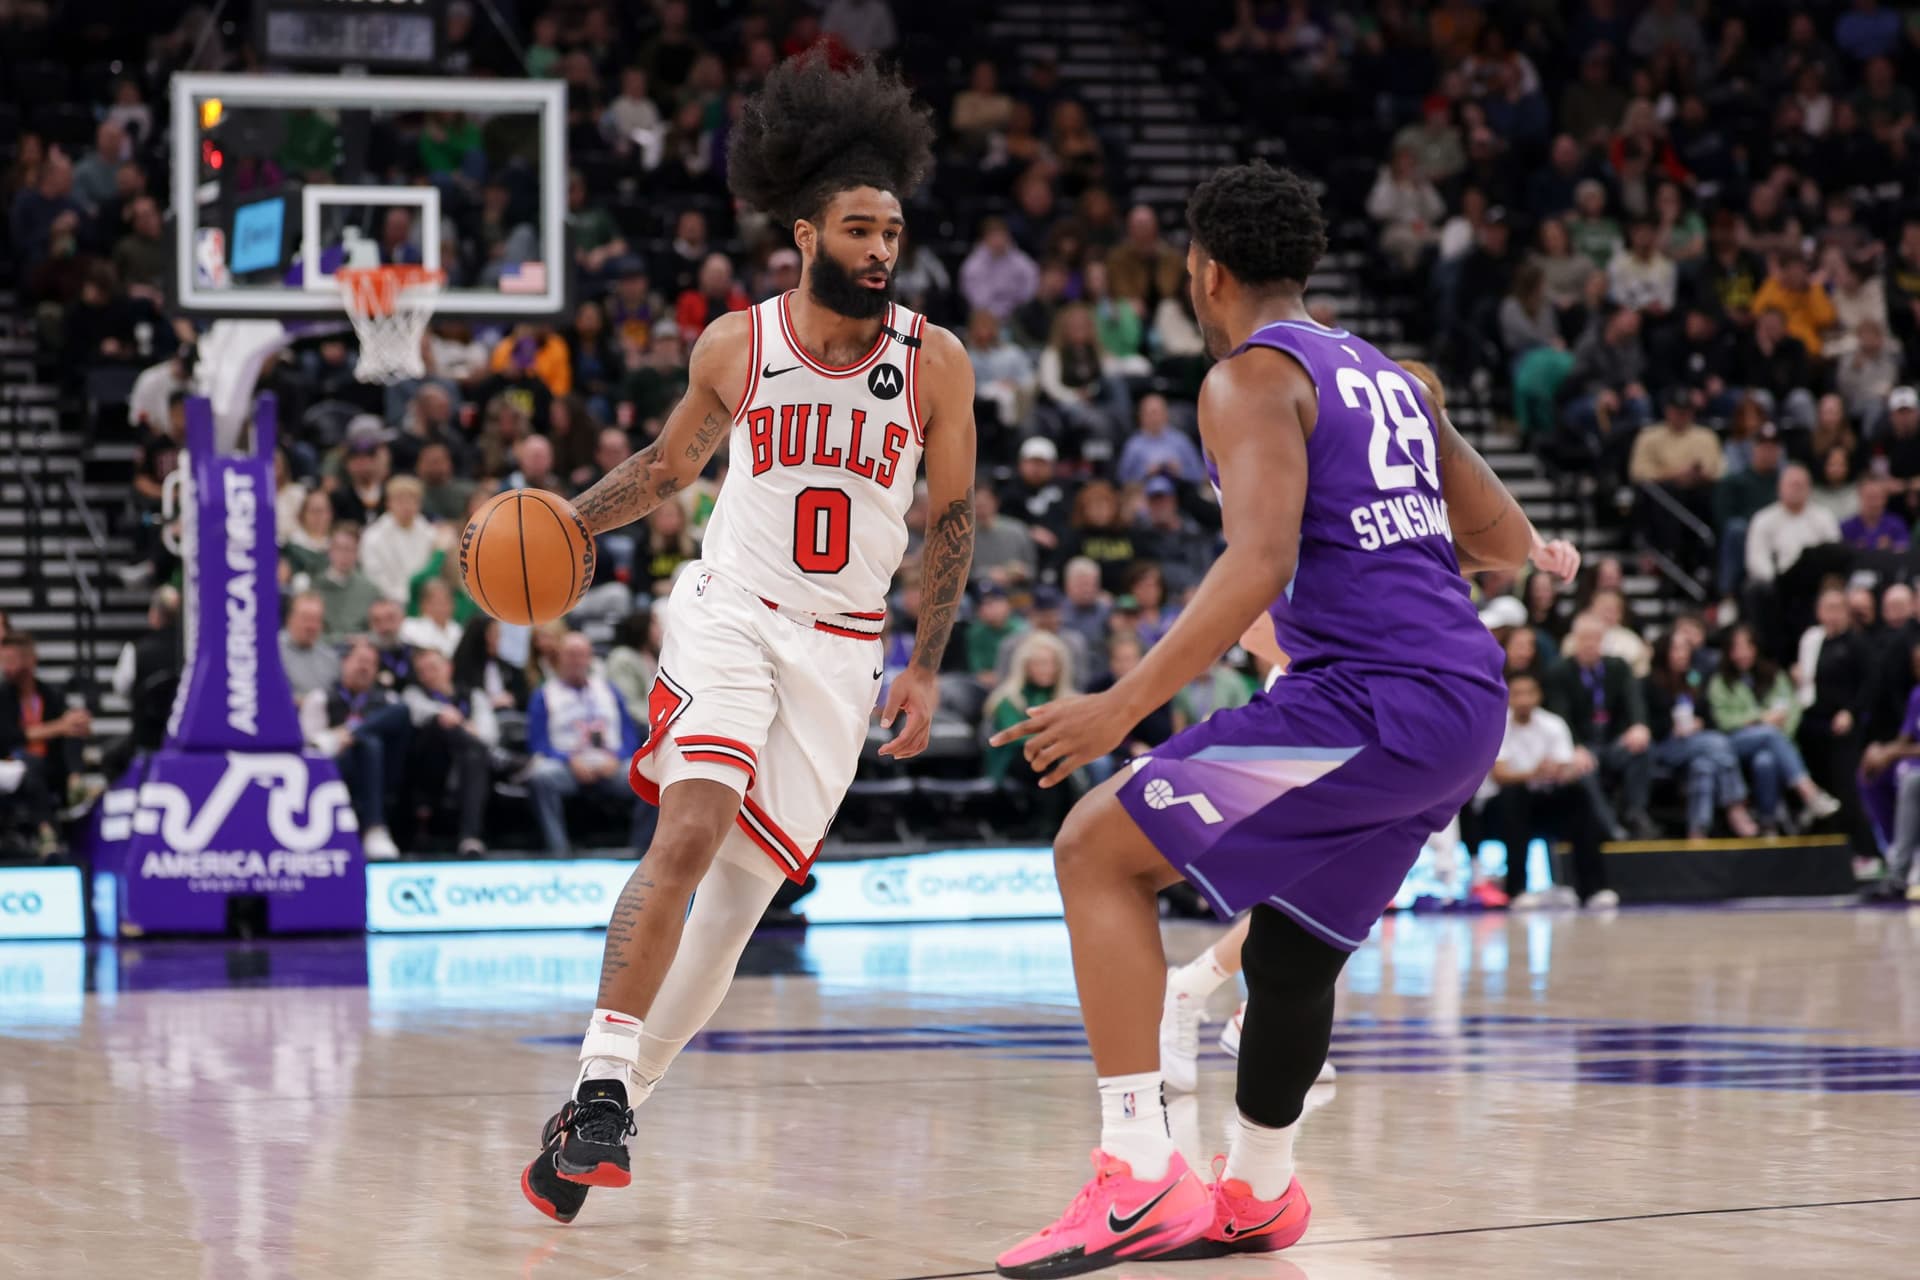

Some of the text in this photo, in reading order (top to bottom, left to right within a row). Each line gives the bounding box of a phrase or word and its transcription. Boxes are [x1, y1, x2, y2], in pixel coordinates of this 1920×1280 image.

[896, 333, 905, 343] 10
[747, 403, 909, 490] BULLS
[1336, 368, 1440, 491] 28
[793, 486, 851, 574] 0
[223, 466, 258, 736] AMERICA FIRST
[141, 850, 351, 879] AMERICA FIRST
[445, 874, 604, 905] awardco
